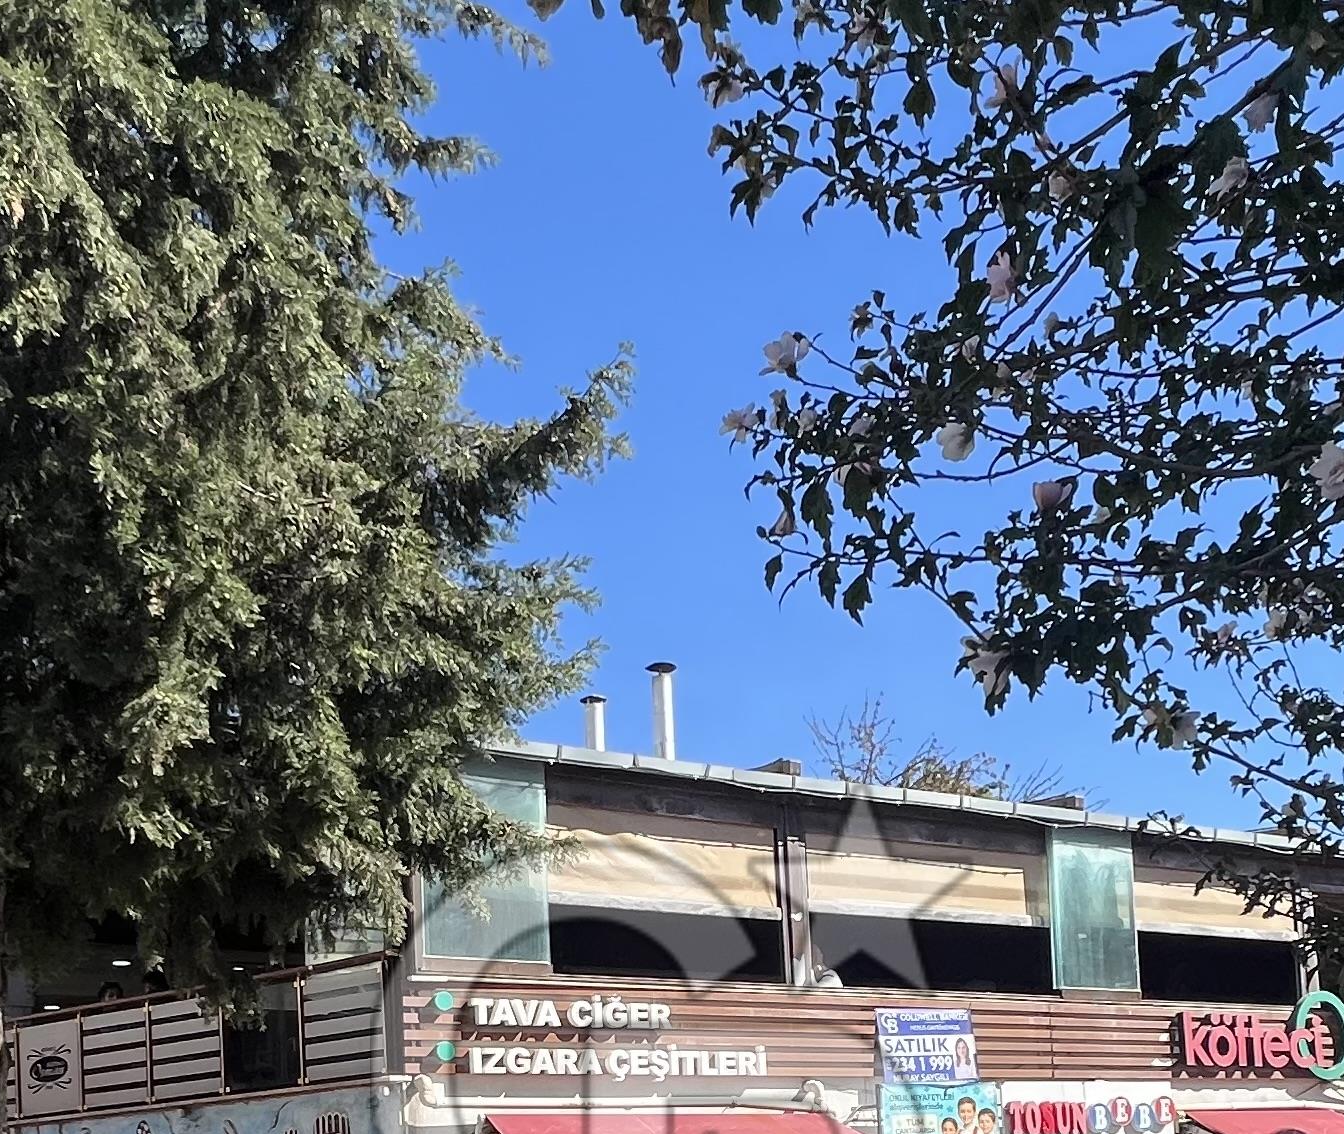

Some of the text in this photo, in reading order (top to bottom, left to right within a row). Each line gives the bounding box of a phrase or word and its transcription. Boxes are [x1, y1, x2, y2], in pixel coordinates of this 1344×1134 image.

[470, 994, 671, 1029] TAVA CİĞER
[884, 1038, 949, 1053] SATILIK
[470, 1045, 768, 1082] IZGARA ÇEŞİTLERİ
[929, 1056, 953, 1071] 999
[1094, 1098, 1172, 1131] BEBE
